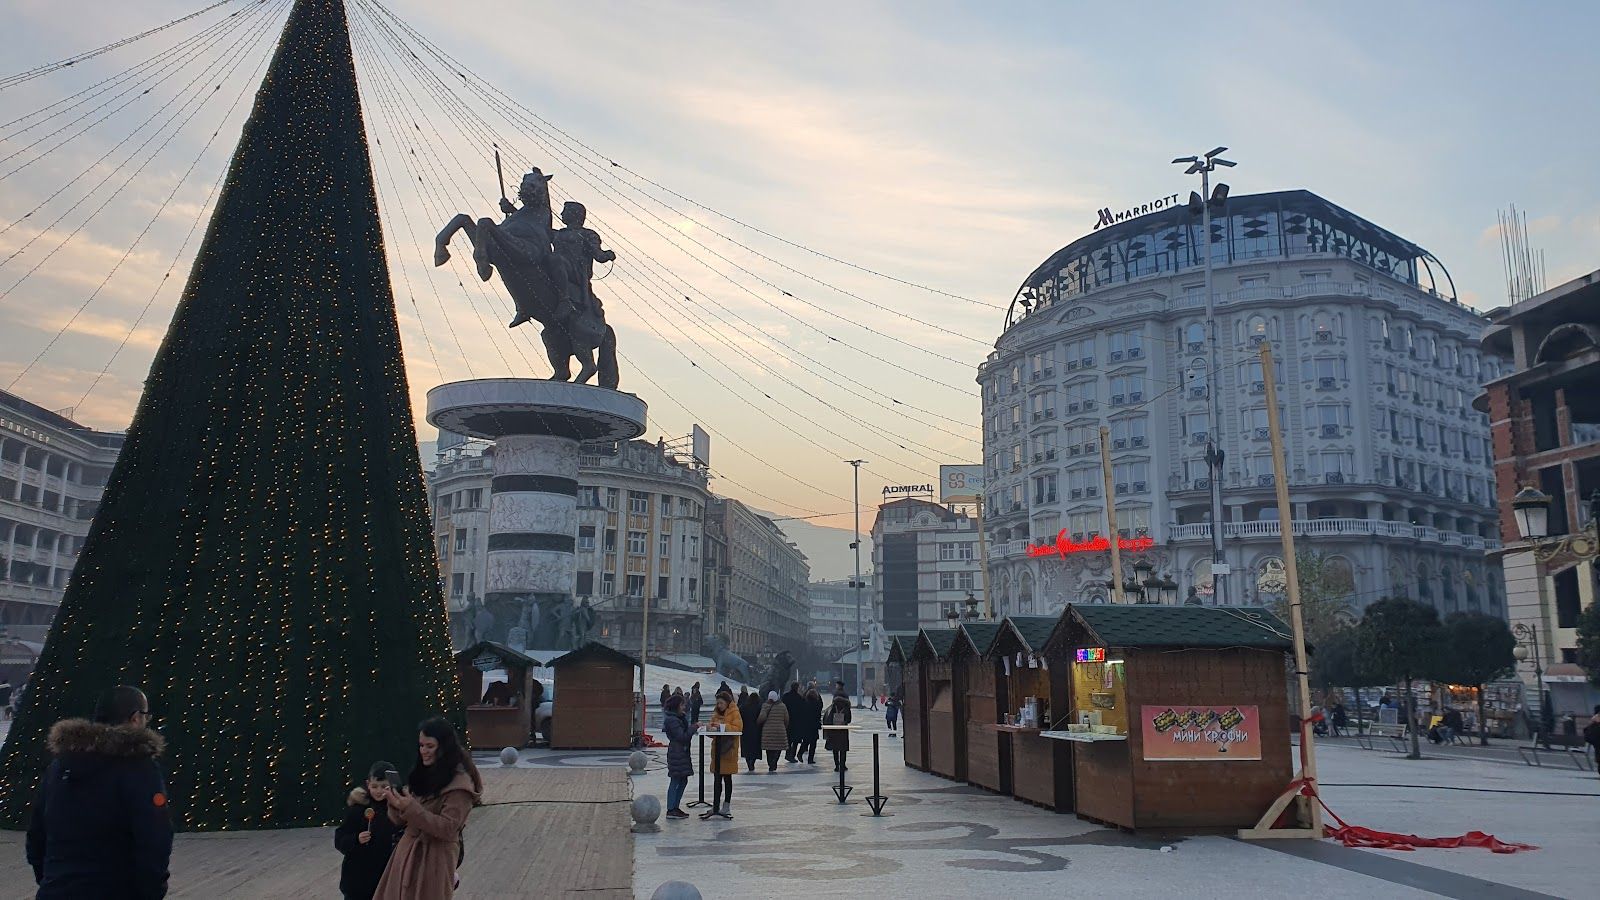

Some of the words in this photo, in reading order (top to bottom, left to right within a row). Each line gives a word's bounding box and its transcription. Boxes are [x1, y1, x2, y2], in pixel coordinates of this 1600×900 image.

[1115, 193, 1179, 222] MARRIOTT
[882, 483, 934, 494] ADMIRAL
[1173, 730, 1201, 743] МИНИ
[1204, 729, 1248, 743] КРОФНИ
